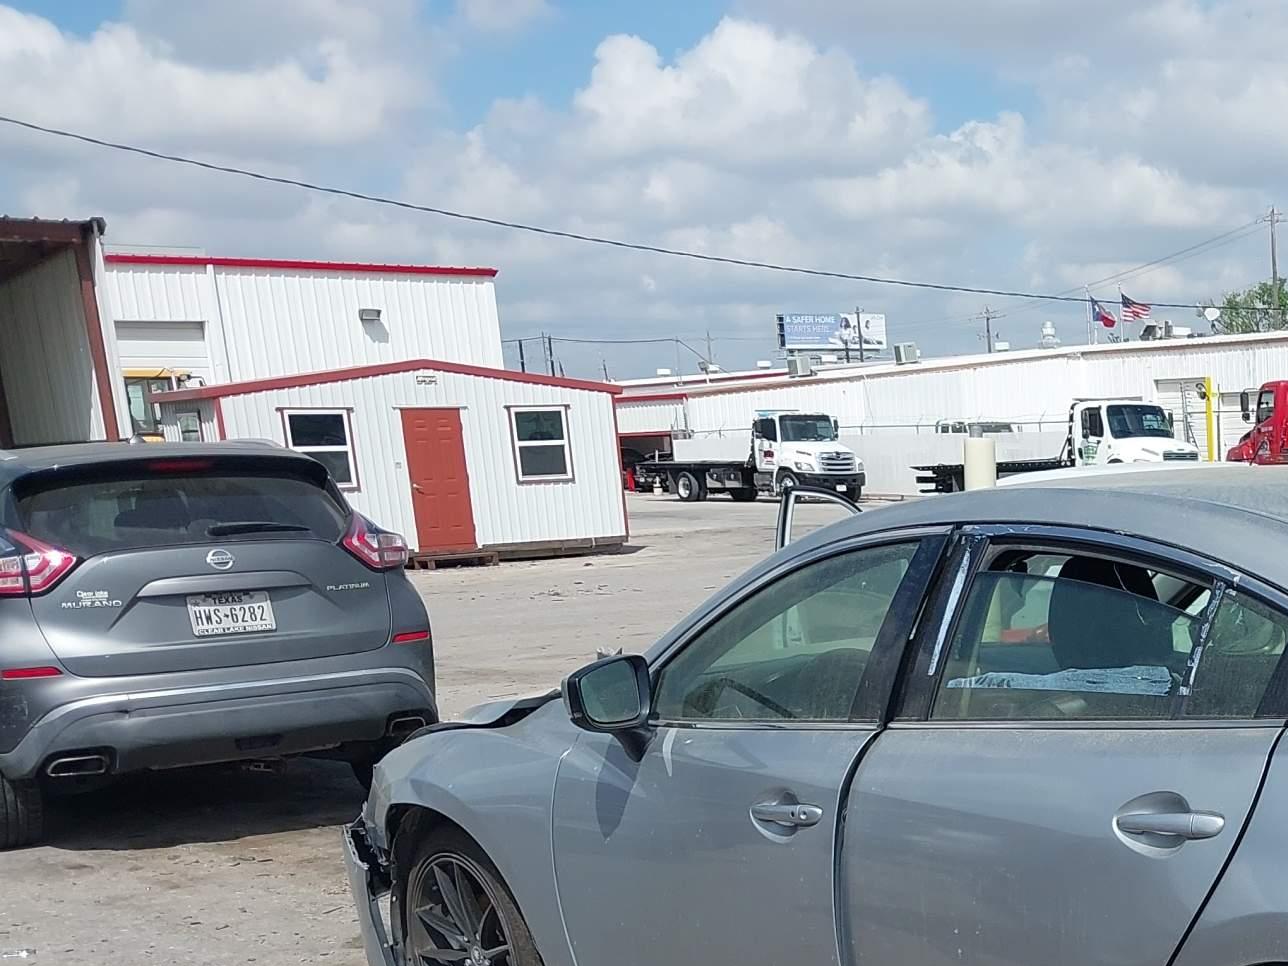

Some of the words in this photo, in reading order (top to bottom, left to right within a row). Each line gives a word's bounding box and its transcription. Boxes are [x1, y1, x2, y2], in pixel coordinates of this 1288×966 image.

[786, 315, 791, 323] A
[792, 315, 814, 324] SAFER
[815, 315, 836, 324] HOME
[326, 582, 370, 591] PLATINUM
[61, 600, 122, 609] MURANO
[212, 596, 243, 605] TEXAS
